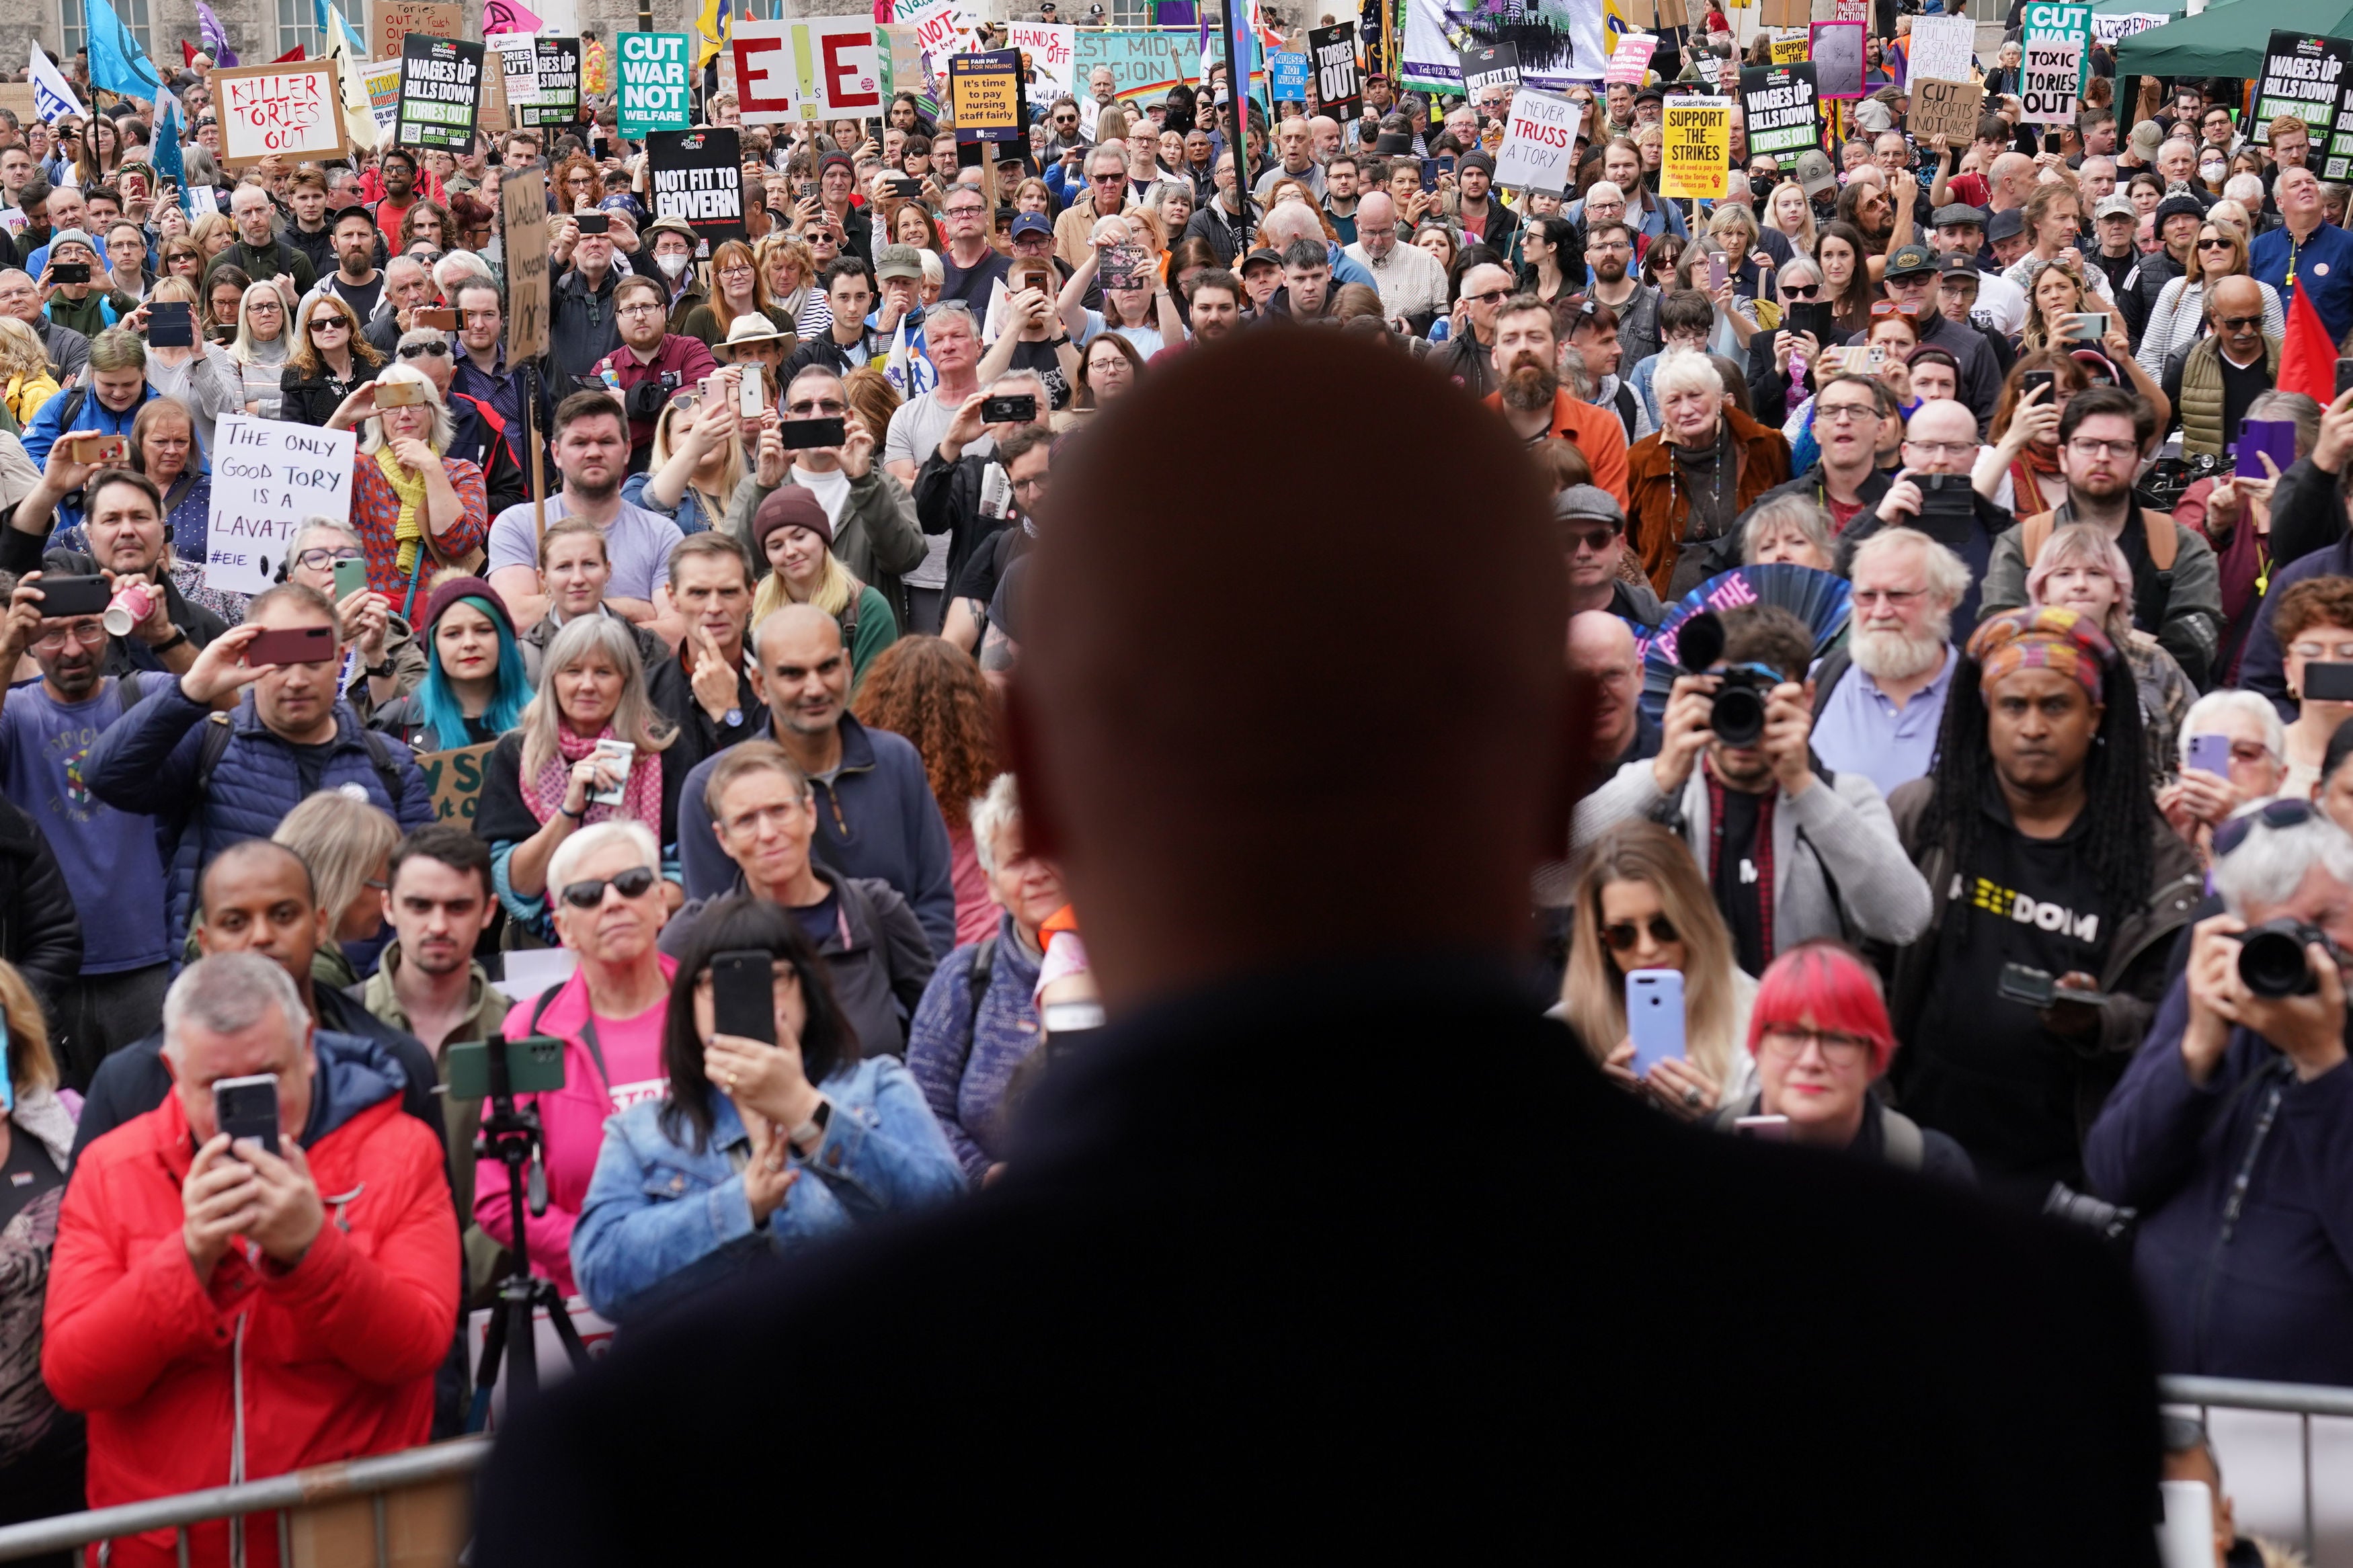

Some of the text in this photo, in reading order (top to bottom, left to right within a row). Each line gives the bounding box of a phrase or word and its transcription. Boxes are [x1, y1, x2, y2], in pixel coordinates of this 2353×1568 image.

[397, 5, 436, 15] Tories
[1837, 2, 1868, 11] PALESTINE
[1837, 10, 1866, 21] ACTION
[386, 15, 450, 27] OUT of Touch
[1914, 17, 1975, 28] JOURNALIST
[2032, 6, 2087, 28] CUT
[917, 10, 955, 48] NOT
[1915, 26, 1972, 43] JULIAN
[1013, 29, 1060, 48] HANDS
[432, 48, 456, 56] peoples
[624, 36, 683, 60] CUT
[1047, 46, 1070, 64] OFF
[1317, 40, 1354, 67] TORIES
[1616, 46, 1627, 54] All
[1775, 41, 1808, 55] SUPPOR
[1911, 40, 1970, 56] ASSANGE
[2297, 44, 2322, 52] peoples
[561, 54, 576, 72] UP
[1613, 54, 1646, 63] refugees
[1788, 53, 1803, 63] THE
[1911, 58, 1968, 75] TORTURED
[1933, 53, 1968, 62] BEING
[2029, 51, 2075, 67] TOXIC
[407, 58, 456, 81] WAGES
[457, 60, 476, 83] UP
[623, 62, 684, 84] WAR
[1076, 61, 1165, 83] RGION
[1283, 66, 1299, 75] NOT
[1418, 65, 1460, 77] Tel: 0121 200
[1610, 63, 1646, 71] welcome!
[2269, 55, 2343, 82] WAGES UP
[549, 73, 576, 89] DOWN
[982, 79, 1006, 87] time
[1278, 76, 1304, 85] NUKES
[1320, 60, 1356, 101] OUT
[1466, 66, 1518, 89] NOT FIT TO
[1936, 73, 1966, 81] THESE
[2026, 73, 2077, 91] TORIES
[231, 75, 322, 106] KILLER
[405, 80, 475, 105] BILLS DOWN
[557, 89, 575, 104] OUT
[625, 85, 684, 109] NOT
[983, 91, 1002, 99] pay
[1747, 81, 1812, 112] WAGES UP
[1923, 83, 1959, 102] CUT
[2263, 77, 2338, 103] BILLS DOWN
[406, 101, 446, 121] TORIES
[446, 106, 471, 124] OUT
[966, 100, 1006, 110] nursing
[1523, 100, 1565, 123] NEVER
[1921, 100, 1974, 120] PROFITS
[2023, 93, 2077, 114] OUT
[233, 102, 319, 129] TORIES
[624, 110, 682, 122] WELFARE
[959, 111, 1013, 120] staff fairly
[1669, 111, 1724, 127] SUPPORT
[1749, 105, 1815, 131] BILLS DOWN
[2305, 105, 2331, 124] OUT
[423, 126, 471, 138] JOIN THE PEOPLE'S
[1514, 118, 1568, 148] TRUSS
[1915, 112, 1973, 136] NOT WAGES
[265, 126, 312, 149] OUT
[422, 134, 466, 147] ASSEMBLY TODAY
[1685, 128, 1706, 144] THE
[1753, 126, 1814, 151] TORIES OUT
[1506, 144, 1559, 168] A TORY
[1672, 145, 1720, 161] STRIKES
[1786, 152, 1795, 161] THE
[655, 167, 738, 192] NOT FIT TO
[656, 189, 740, 219] GOVERN
[9, 216, 26, 226] PAY
[225, 423, 336, 457] THE ONLY
[221, 456, 342, 492] GOOD TORY
[253, 489, 292, 508] IS A
[210, 550, 247, 565] #EIE
[1707, 572, 1758, 612] THE
